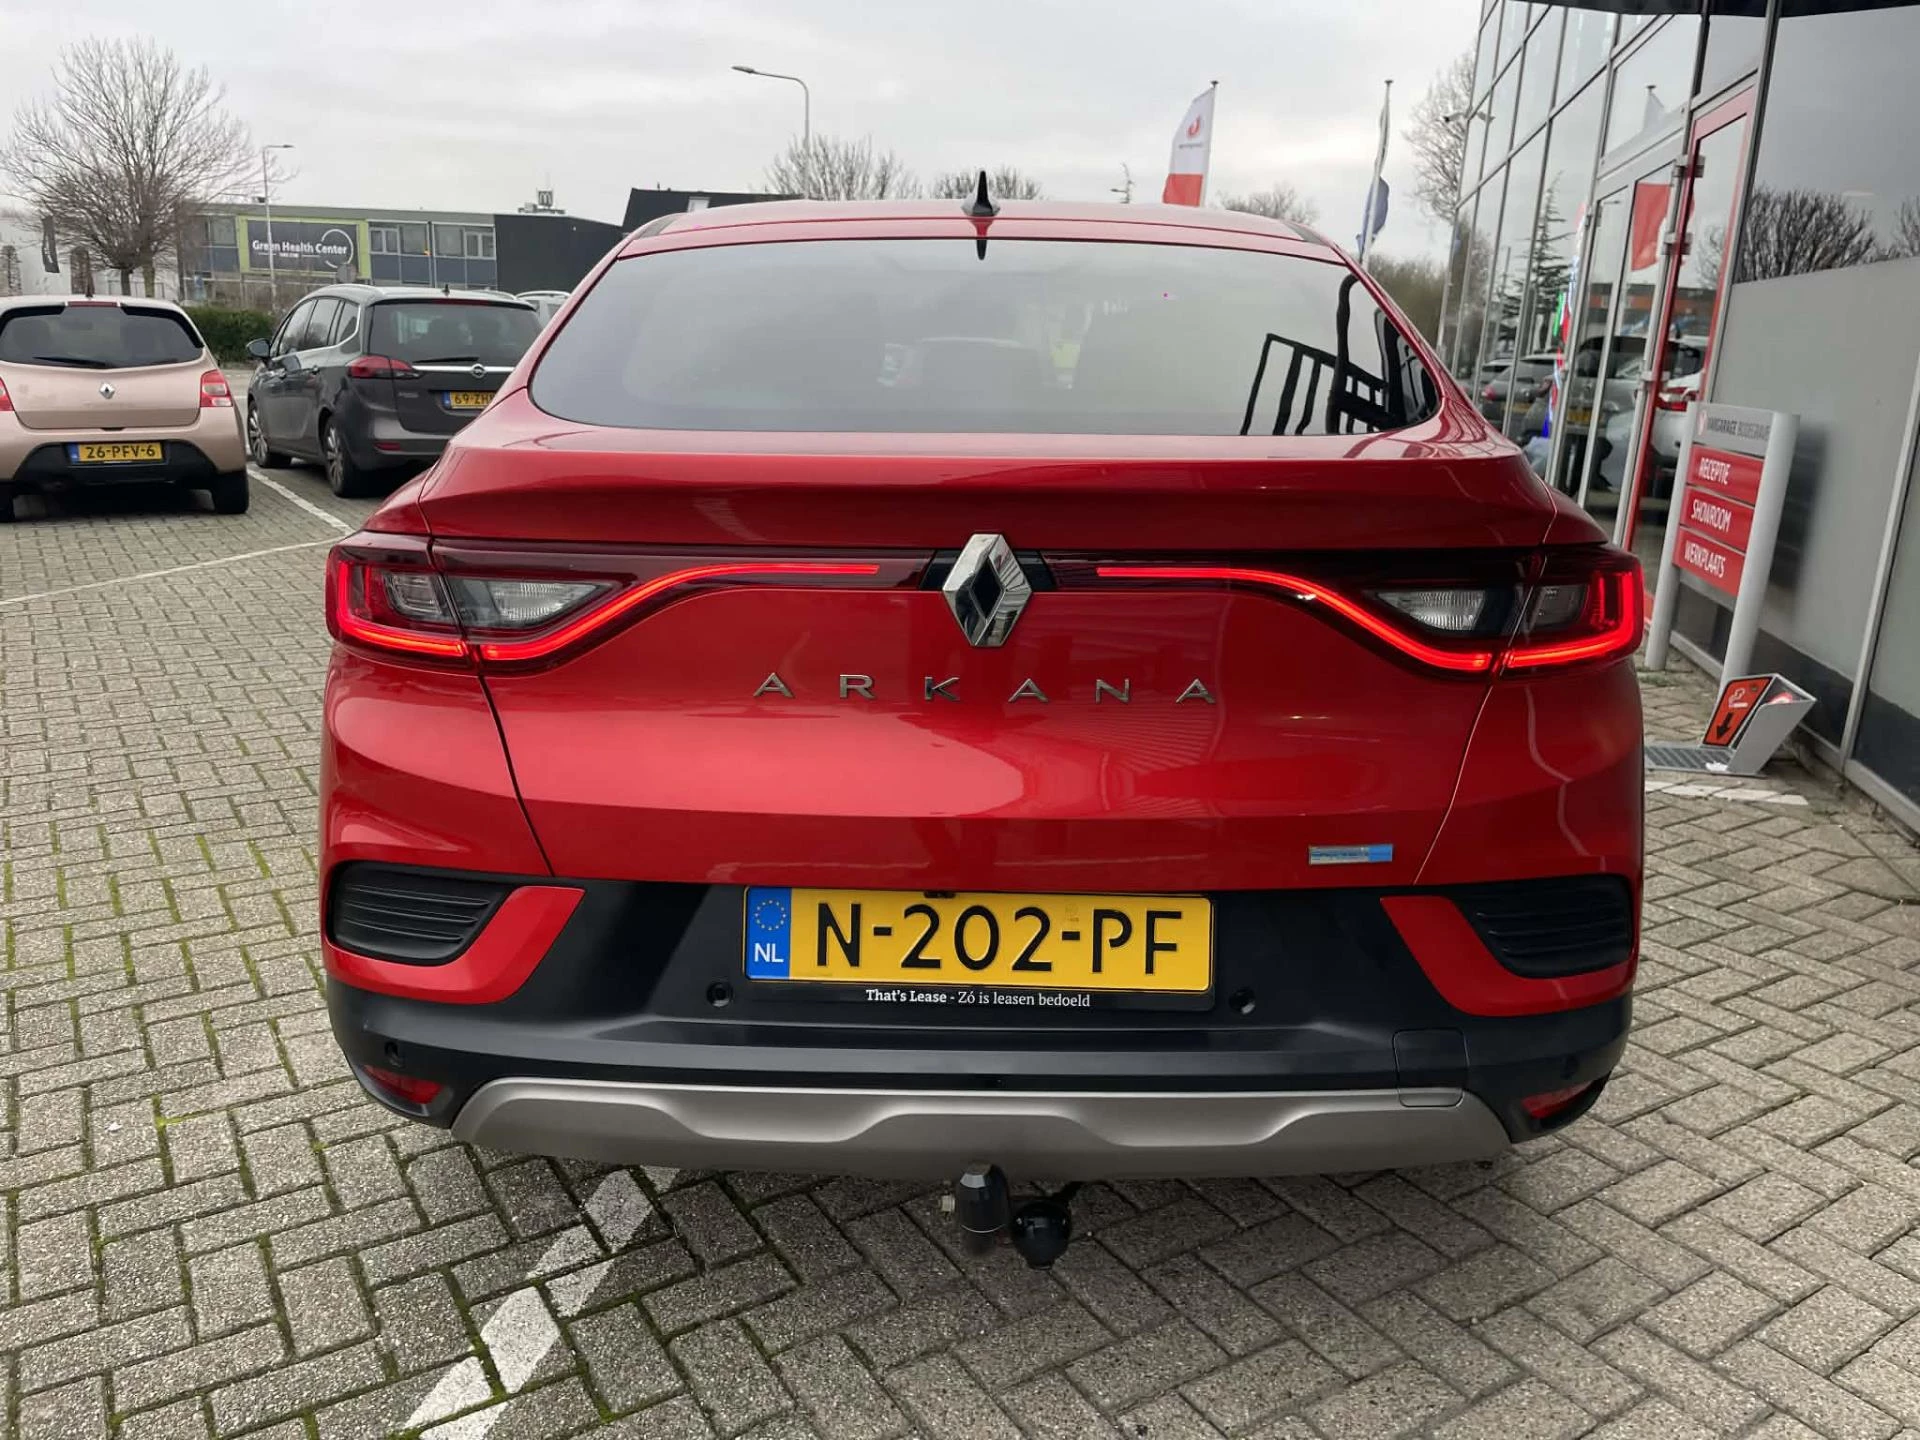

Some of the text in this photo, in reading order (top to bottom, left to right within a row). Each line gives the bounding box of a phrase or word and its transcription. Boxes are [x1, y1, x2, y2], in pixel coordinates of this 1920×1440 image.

[282, 241, 314, 253] Health
[315, 243, 348, 255] Center
[85, 444, 156, 459] 26-PFV-6
[1698, 457, 1731, 485] RECEPTIE
[1691, 498, 1731, 532] SHOWROOM
[1684, 540, 1726, 578] WERKPLAATS
[752, 671, 1216, 704] ARKANA
[815, 901, 1183, 975] N-202-PF
[753, 942, 785, 963] NL
[866, 989, 907, 1002] That's
[909, 990, 947, 1003] Lease
[958, 991, 976, 1004] Zó
[979, 991, 990, 1005] is
[993, 991, 1036, 1006] leasen
[1038, 993, 1091, 1007] bedoeld
